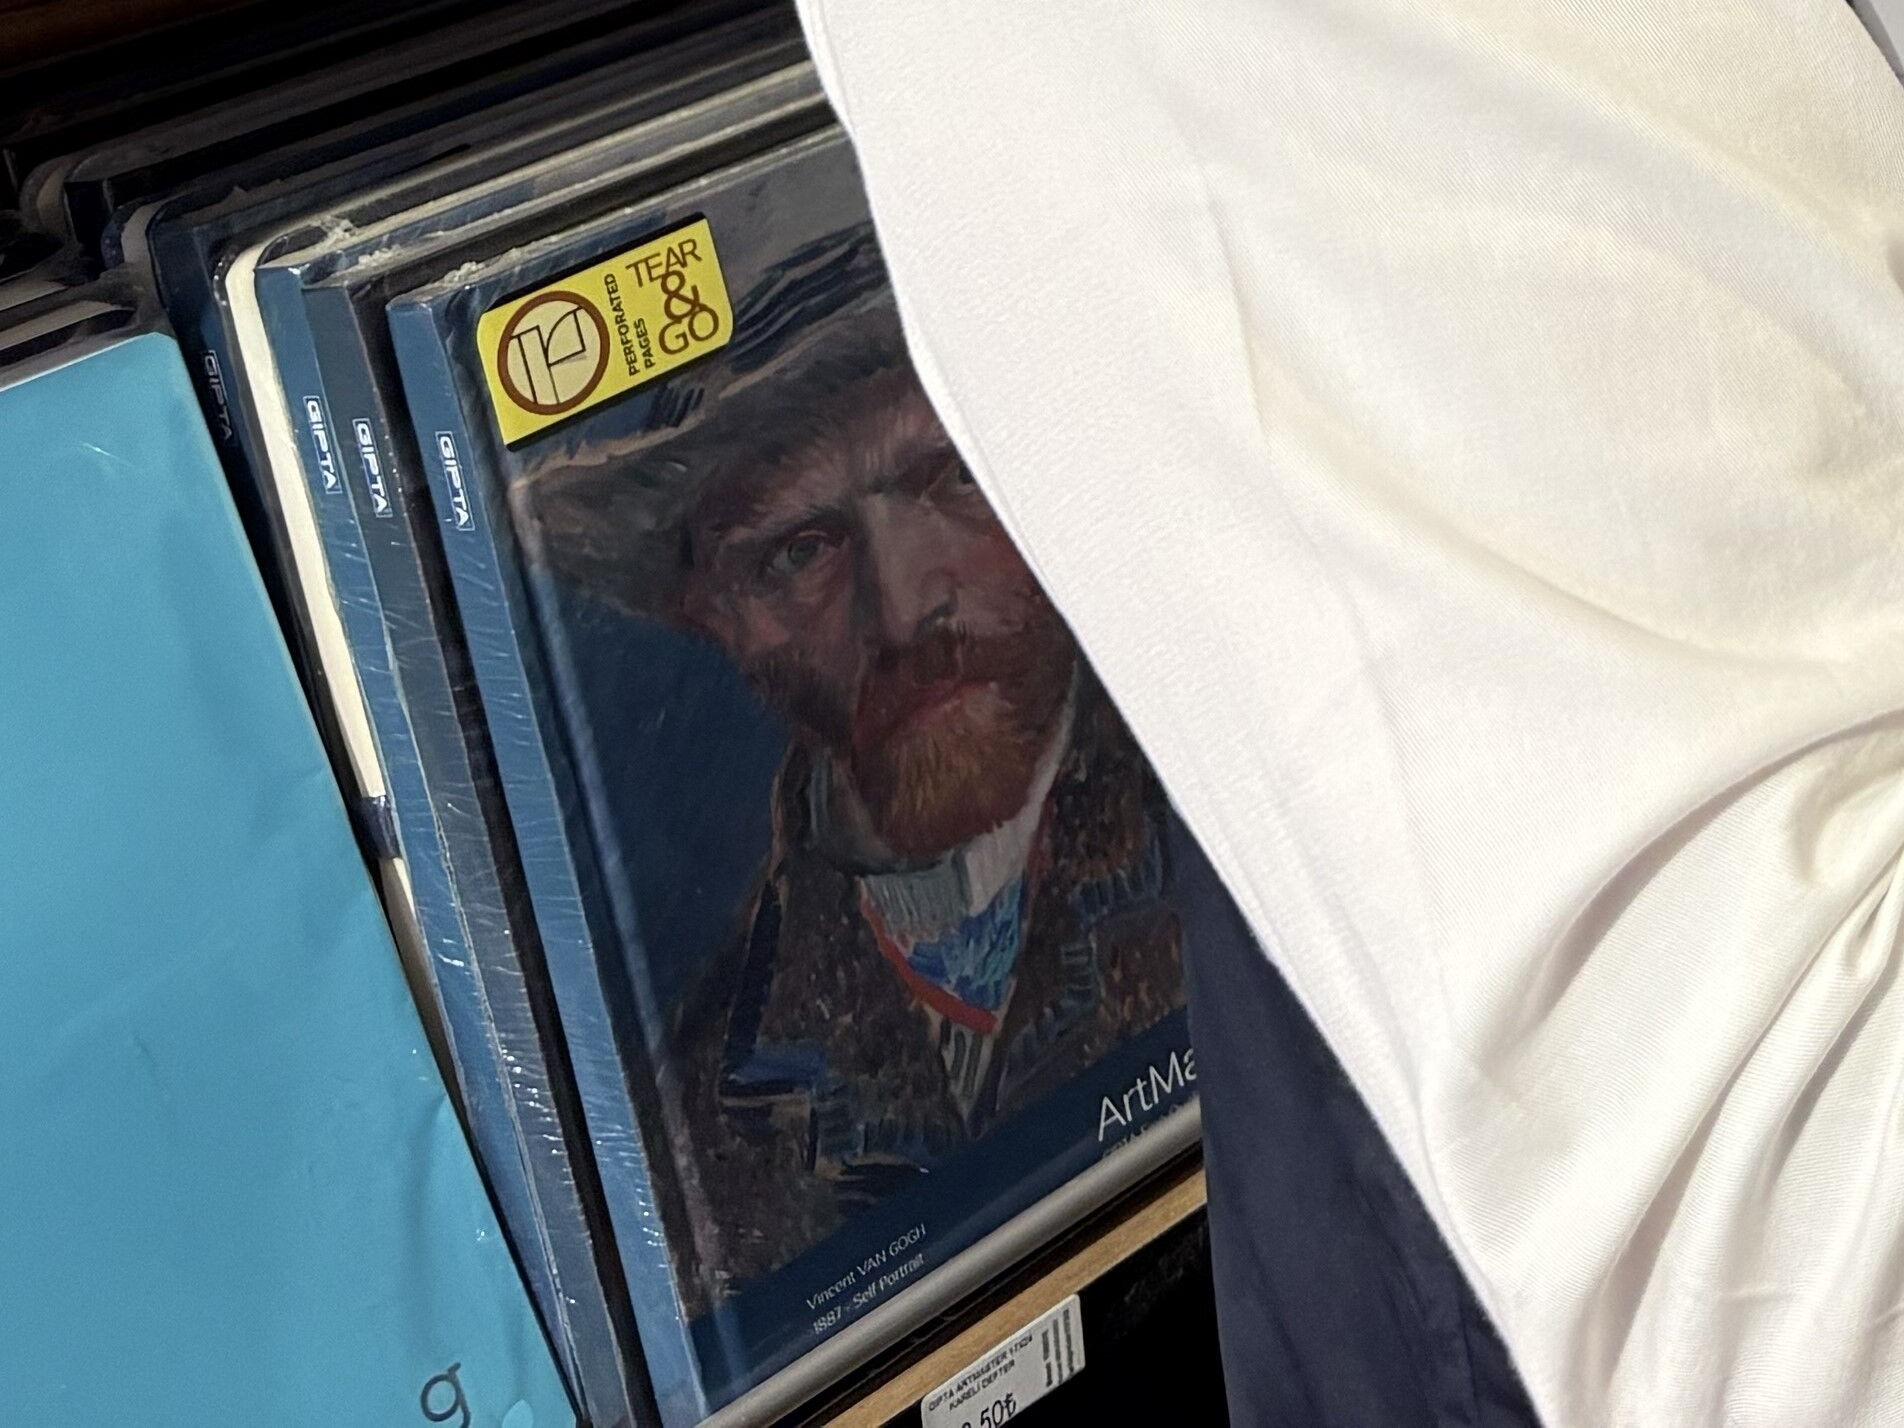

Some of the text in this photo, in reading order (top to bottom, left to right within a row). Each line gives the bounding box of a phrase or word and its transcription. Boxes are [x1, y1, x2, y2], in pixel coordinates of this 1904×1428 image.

[625, 238, 703, 288] TEAR
[660, 270, 701, 321] &
[603, 272, 641, 377] PERFORATED
[632, 317, 656, 370] PAGES
[658, 305, 720, 356] GO
[204, 353, 233, 441] GIPTA
[307, 398, 339, 490] GIPTA
[356, 421, 389, 515] GIPTA
[440, 434, 470, 528] GIPTA
[1098, 1048, 1198, 1142] ArtMa
[806, 1223, 927, 1310] Vincent VAN GOGH
[813, 1306, 842, 1335] 1887
[852, 1282, 878, 1309] Self
[879, 1253, 925, 1291] Portrait
